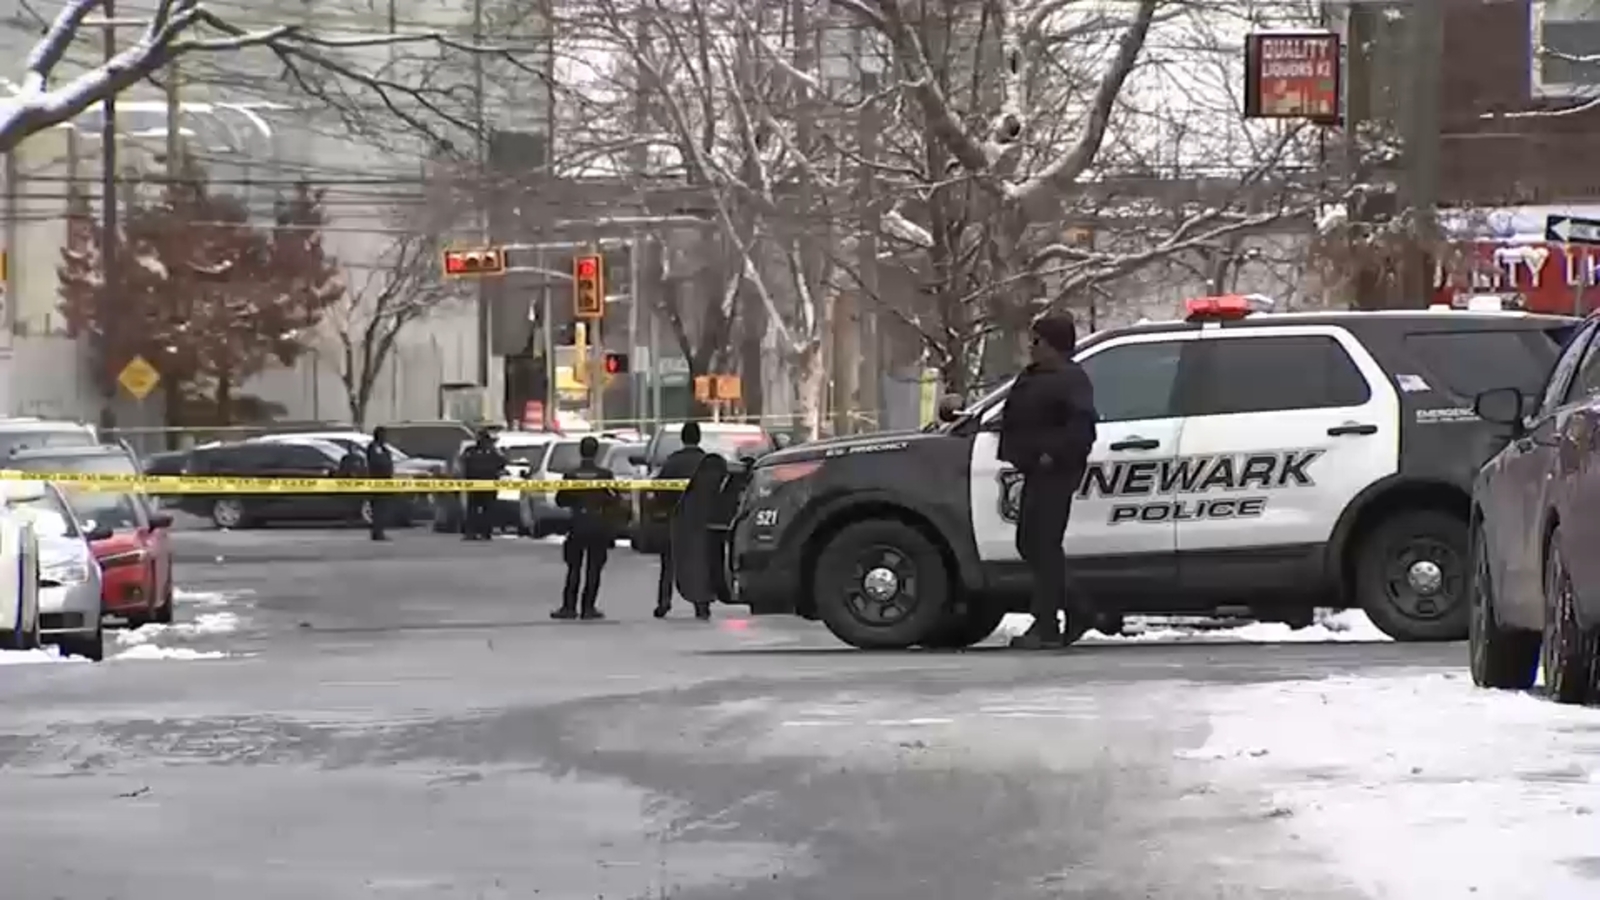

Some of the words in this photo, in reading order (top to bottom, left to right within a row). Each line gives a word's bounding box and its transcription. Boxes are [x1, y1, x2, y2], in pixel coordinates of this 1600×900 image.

[1262, 39, 1329, 59] QUALITY
[1262, 60, 1313, 77] LIQUORS
[1416, 407, 1475, 418] EMERGENC
[1075, 450, 1327, 500] NEWARK
[755, 508, 780, 526] 521
[1107, 497, 1268, 525] POLICE
